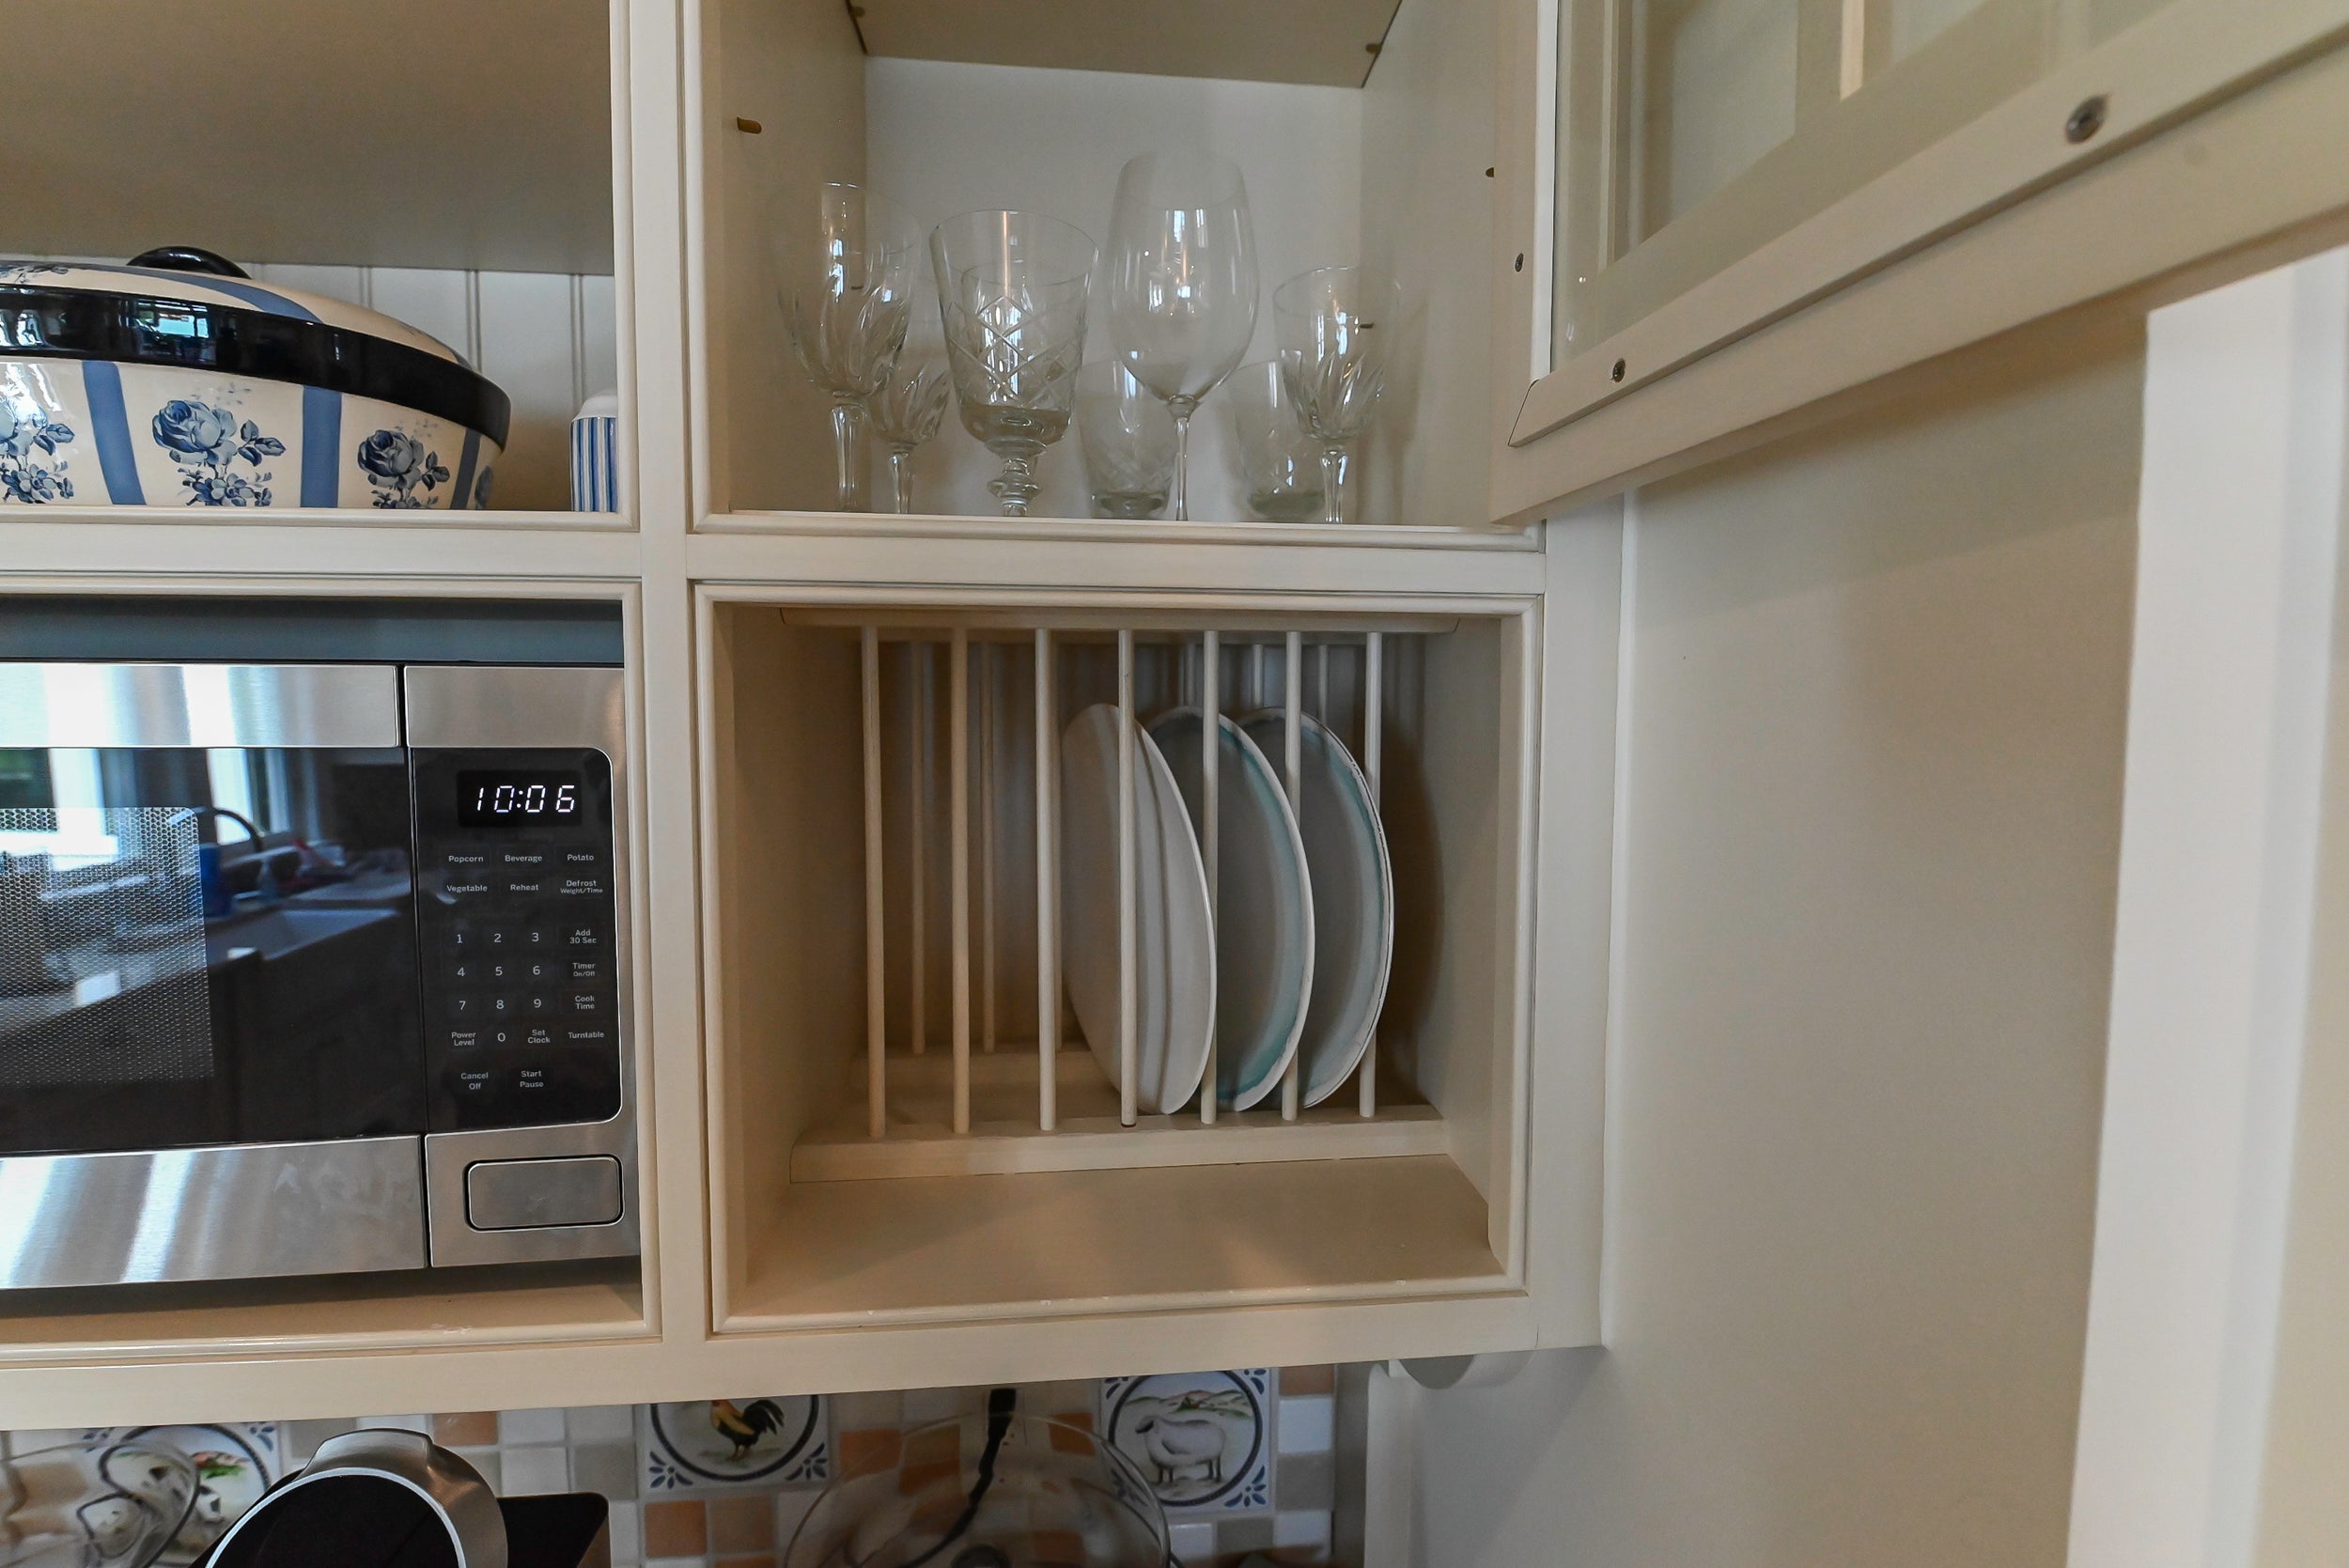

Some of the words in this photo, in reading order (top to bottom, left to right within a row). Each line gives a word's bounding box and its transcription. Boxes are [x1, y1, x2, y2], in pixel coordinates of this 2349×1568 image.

[476, 784, 575, 813] 10:06
[457, 934, 462, 943] 1
[494, 933, 502, 942] 2
[532, 932, 539, 941] 3
[458, 967, 465, 977] 4
[495, 967, 503, 976] 5
[533, 966, 540, 975] 6
[459, 1001, 466, 1010] 7
[496, 1000, 504, 1009] 8
[534, 999, 541, 1008] 9
[498, 1032, 506, 1042] 0
